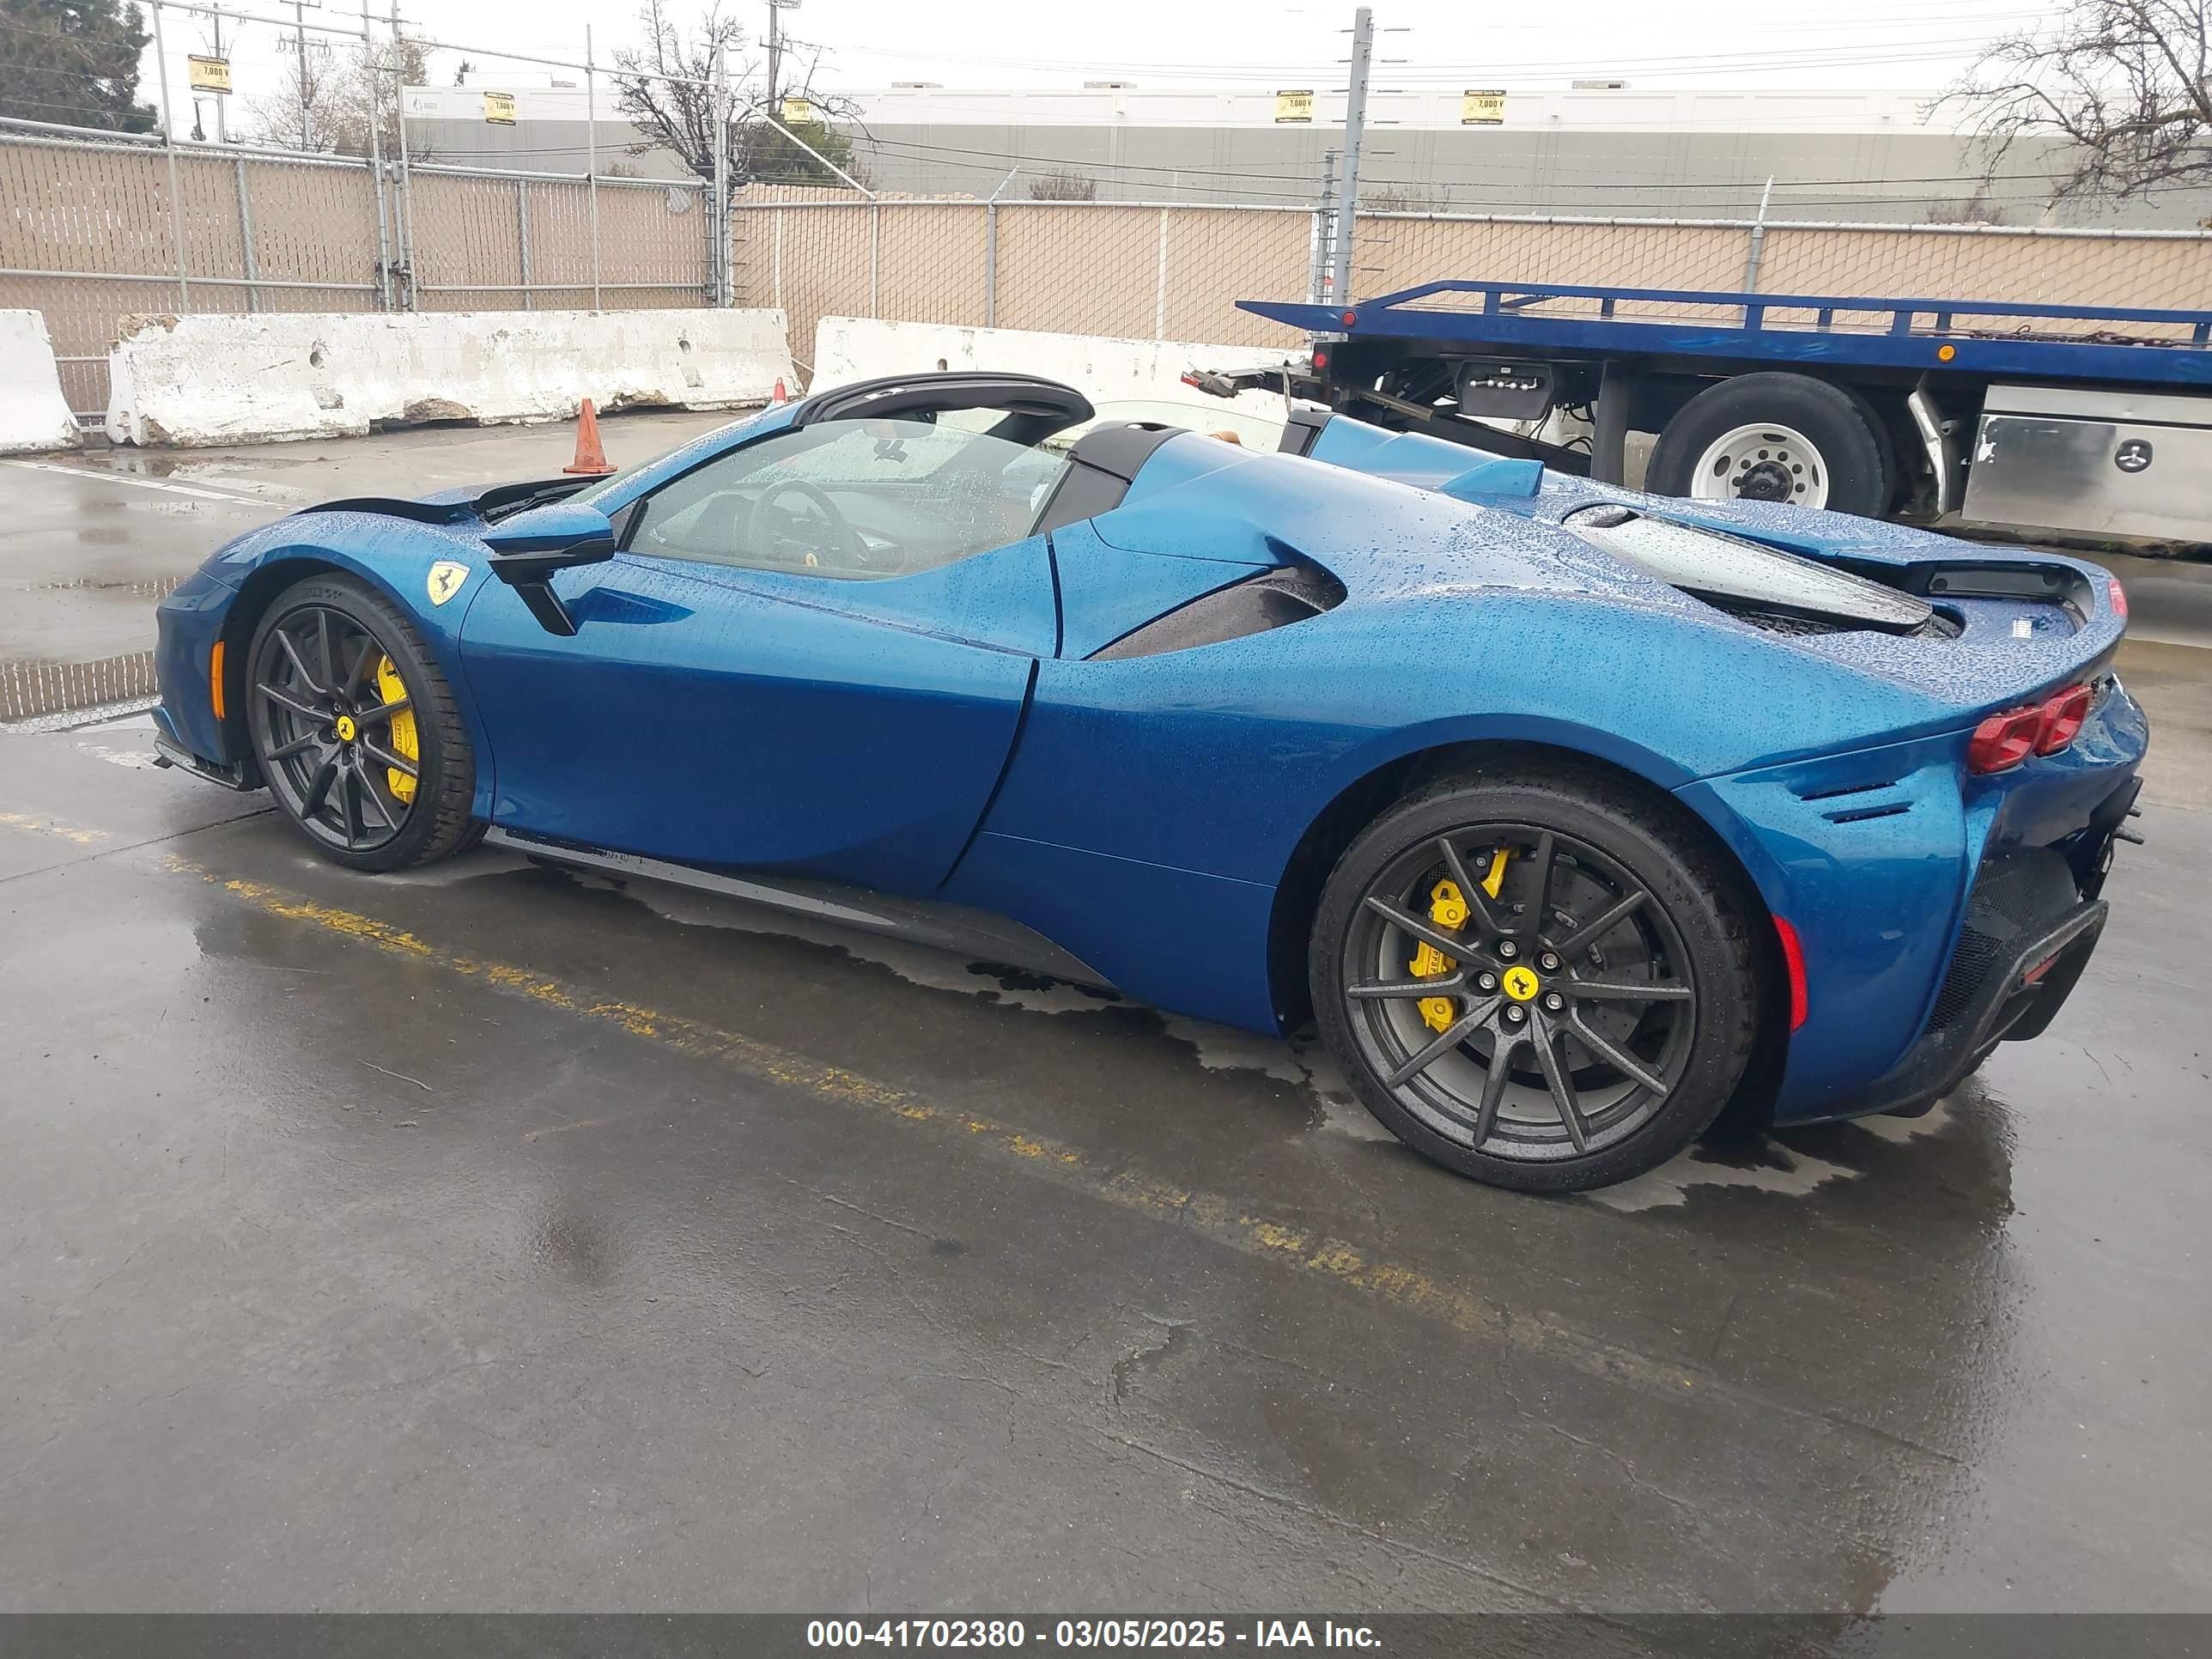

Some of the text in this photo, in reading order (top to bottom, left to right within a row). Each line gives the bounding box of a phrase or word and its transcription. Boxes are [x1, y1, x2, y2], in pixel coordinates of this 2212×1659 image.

[204, 66, 229, 77] 7,000 V
[1290, 99, 1312, 108] 7,000 V
[1478, 100, 1504, 109] 7,000 V
